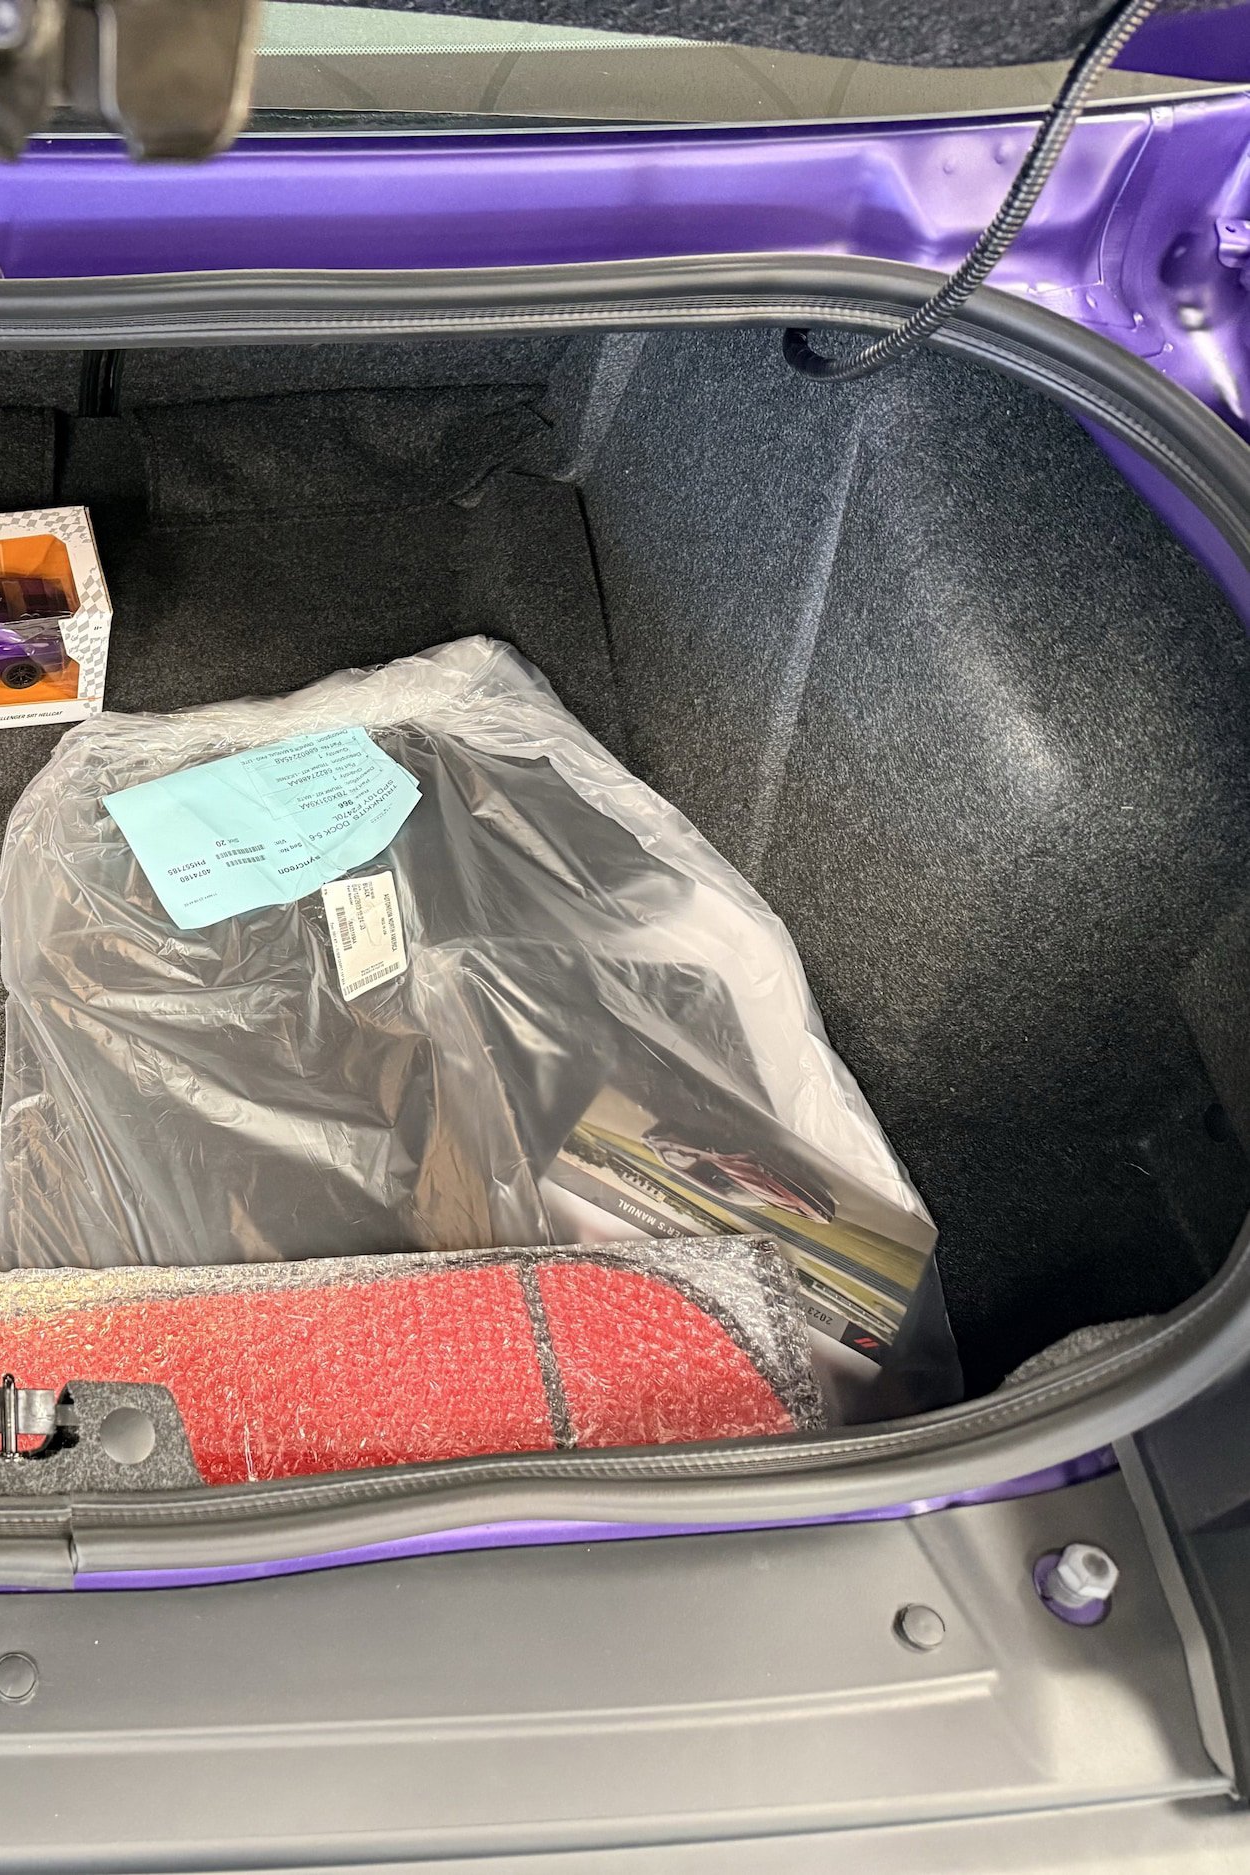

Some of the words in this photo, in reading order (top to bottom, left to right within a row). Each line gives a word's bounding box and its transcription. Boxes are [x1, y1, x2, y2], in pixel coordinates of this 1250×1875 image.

[295, 793, 312, 802] MATS
[363, 779, 393, 805] SPD10Y
[337, 798, 354, 809] 966
[352, 784, 397, 820] TRUNKKITS
[307, 831, 323, 841] 5-6
[324, 820, 350, 836] DOCK
[214, 839, 227, 847] 20
[167, 859, 206, 875] PH557185
[277, 854, 321, 874] syncreon
[179, 868, 211, 883] 4074180
[361, 882, 370, 898] BLACK
[383, 892, 393, 918] AUTONEUM
[387, 916, 395, 933] NORTH
[614, 1197, 657, 1226] MANUAL
[807, 1306, 833, 1325] 2023
